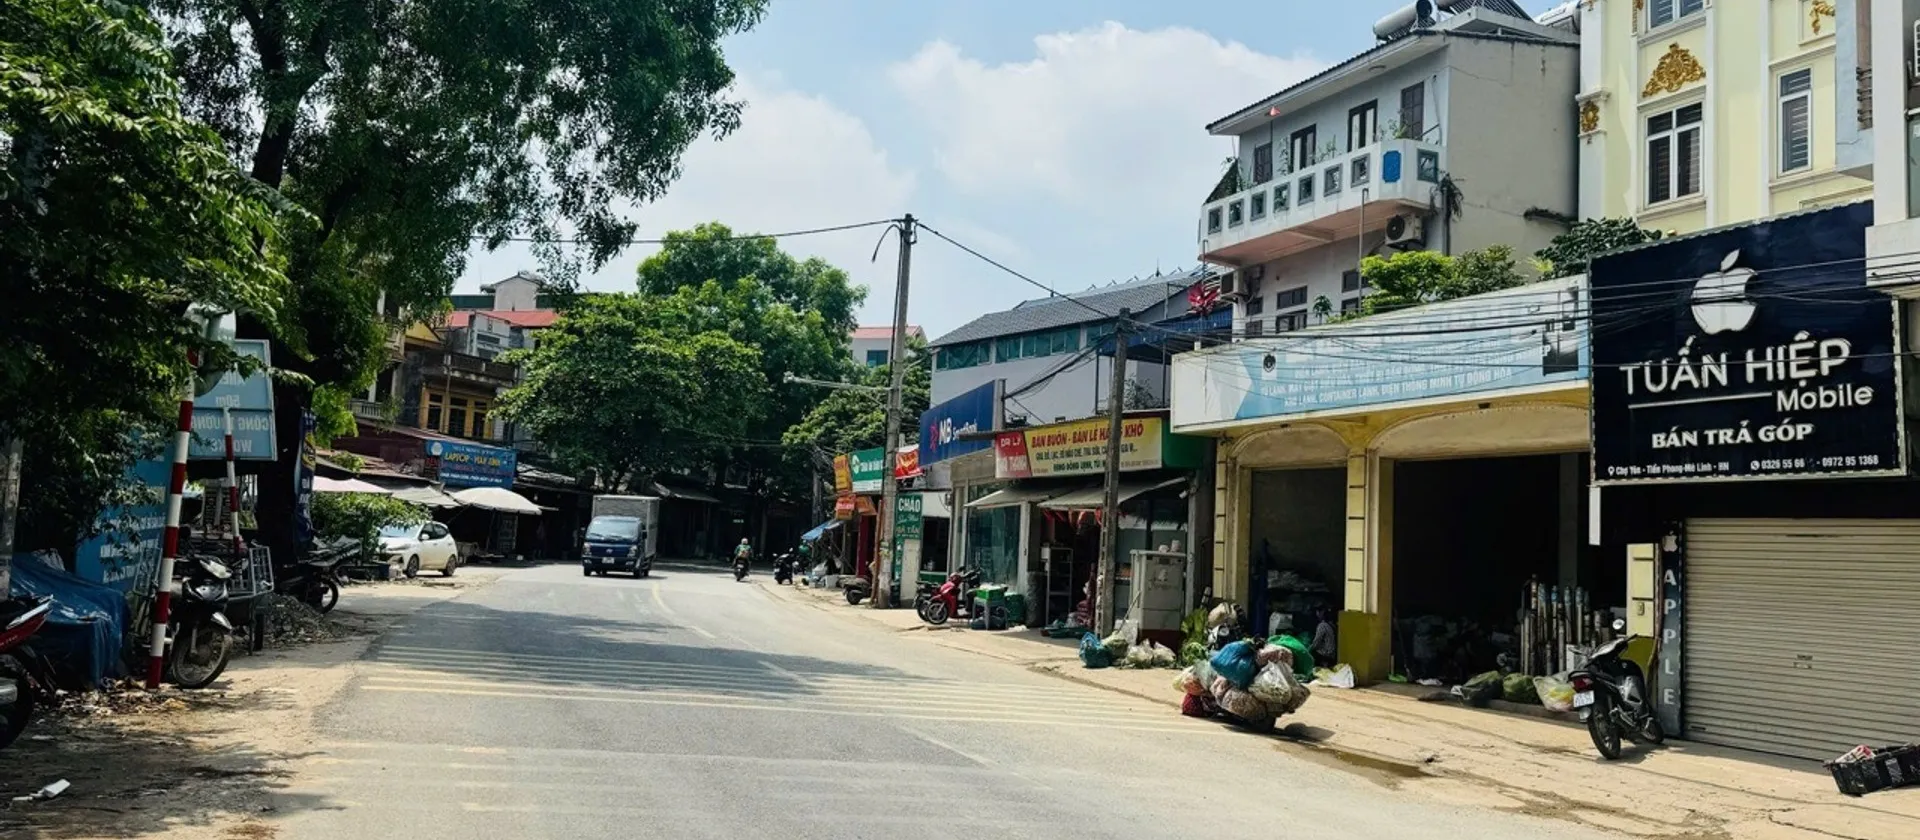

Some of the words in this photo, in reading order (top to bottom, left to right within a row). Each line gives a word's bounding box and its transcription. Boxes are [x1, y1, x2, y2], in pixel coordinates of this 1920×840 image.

[1618, 334, 1730, 395] TUẤN
[1745, 330, 1852, 387] HIỆP
[1429, 375, 1452, 389] MINH
[1776, 383, 1874, 413] Mobile
[939, 417, 952, 445] MB
[1046, 430, 1068, 447] BUÔN
[1651, 425, 1699, 449] BÁN
[1704, 420, 1753, 445] TRẢ
[1758, 416, 1814, 442] GÓP
[444, 451, 469, 467] LAPTOP
[1696, 462, 1713, 472] Linh
[1782, 458, 1793, 469] 55
[1822, 456, 1843, 467] 0972
[1844, 455, 1856, 466] 95
[1662, 568, 1678, 705] APPLE
